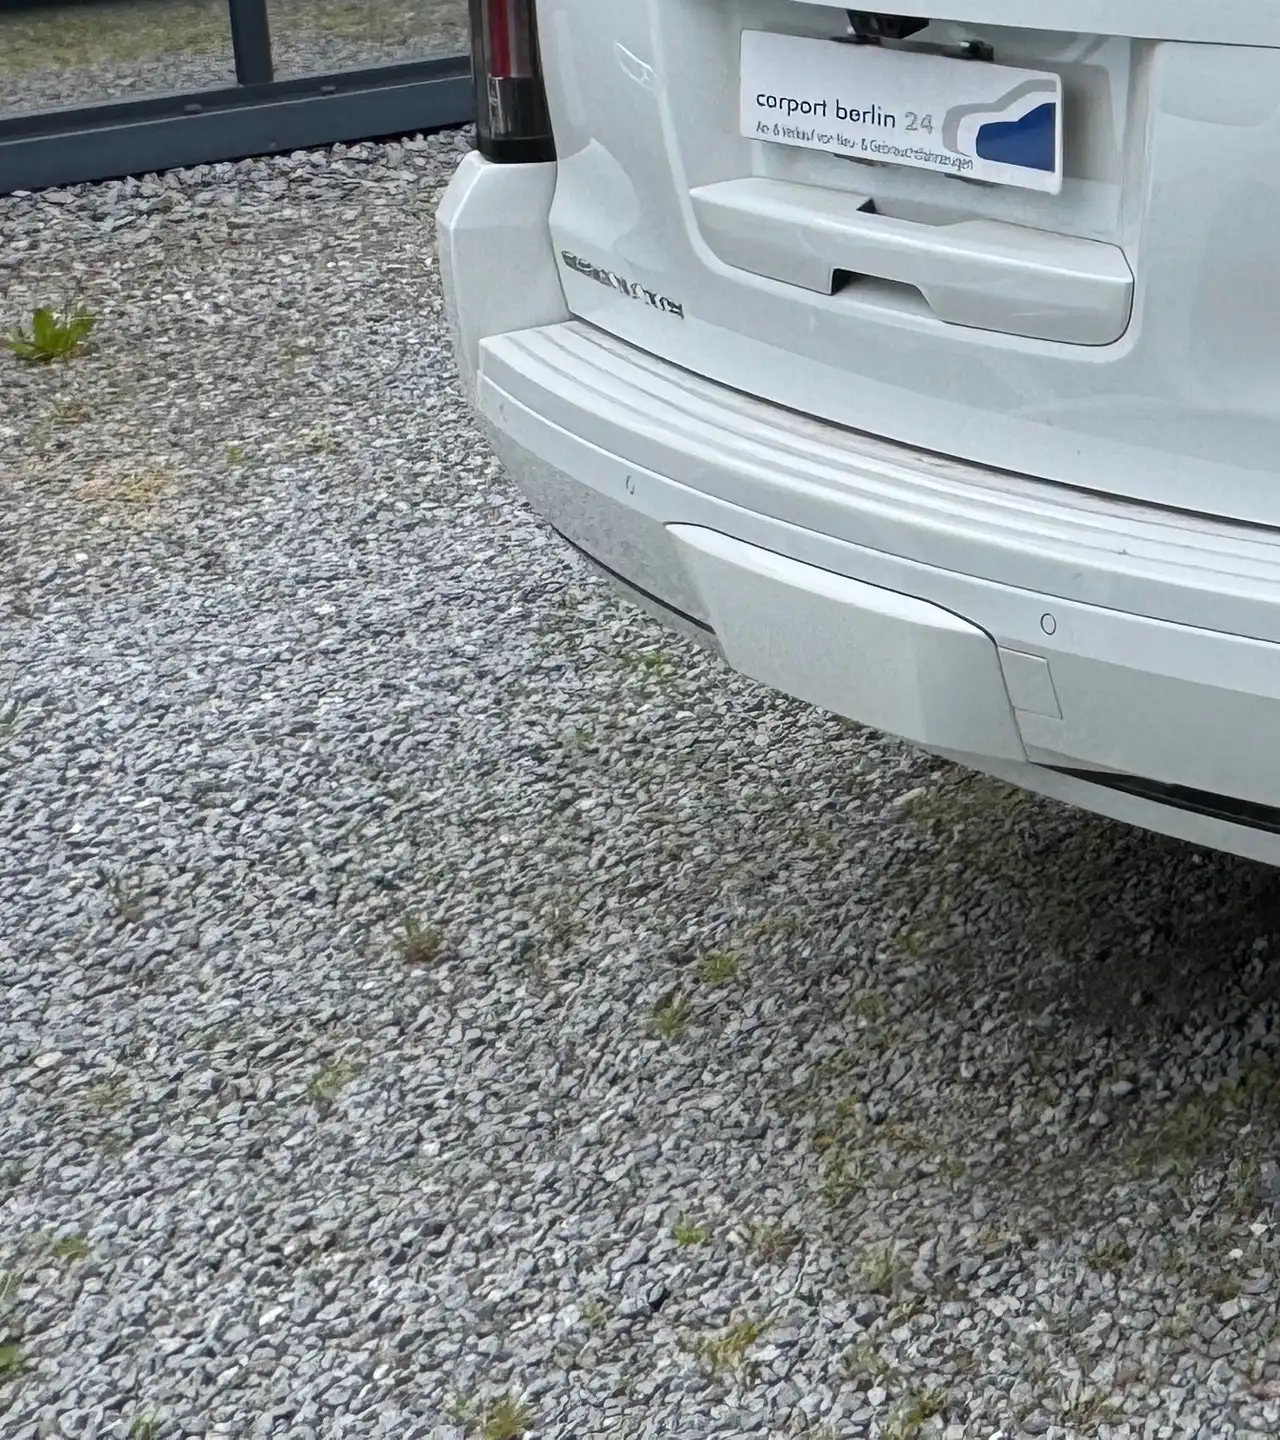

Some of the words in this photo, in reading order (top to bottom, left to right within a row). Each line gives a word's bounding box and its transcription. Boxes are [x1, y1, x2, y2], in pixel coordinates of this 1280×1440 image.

[756, 93, 827, 116] carport
[836, 99, 896, 128] berlin
[905, 111, 933, 135] 24
